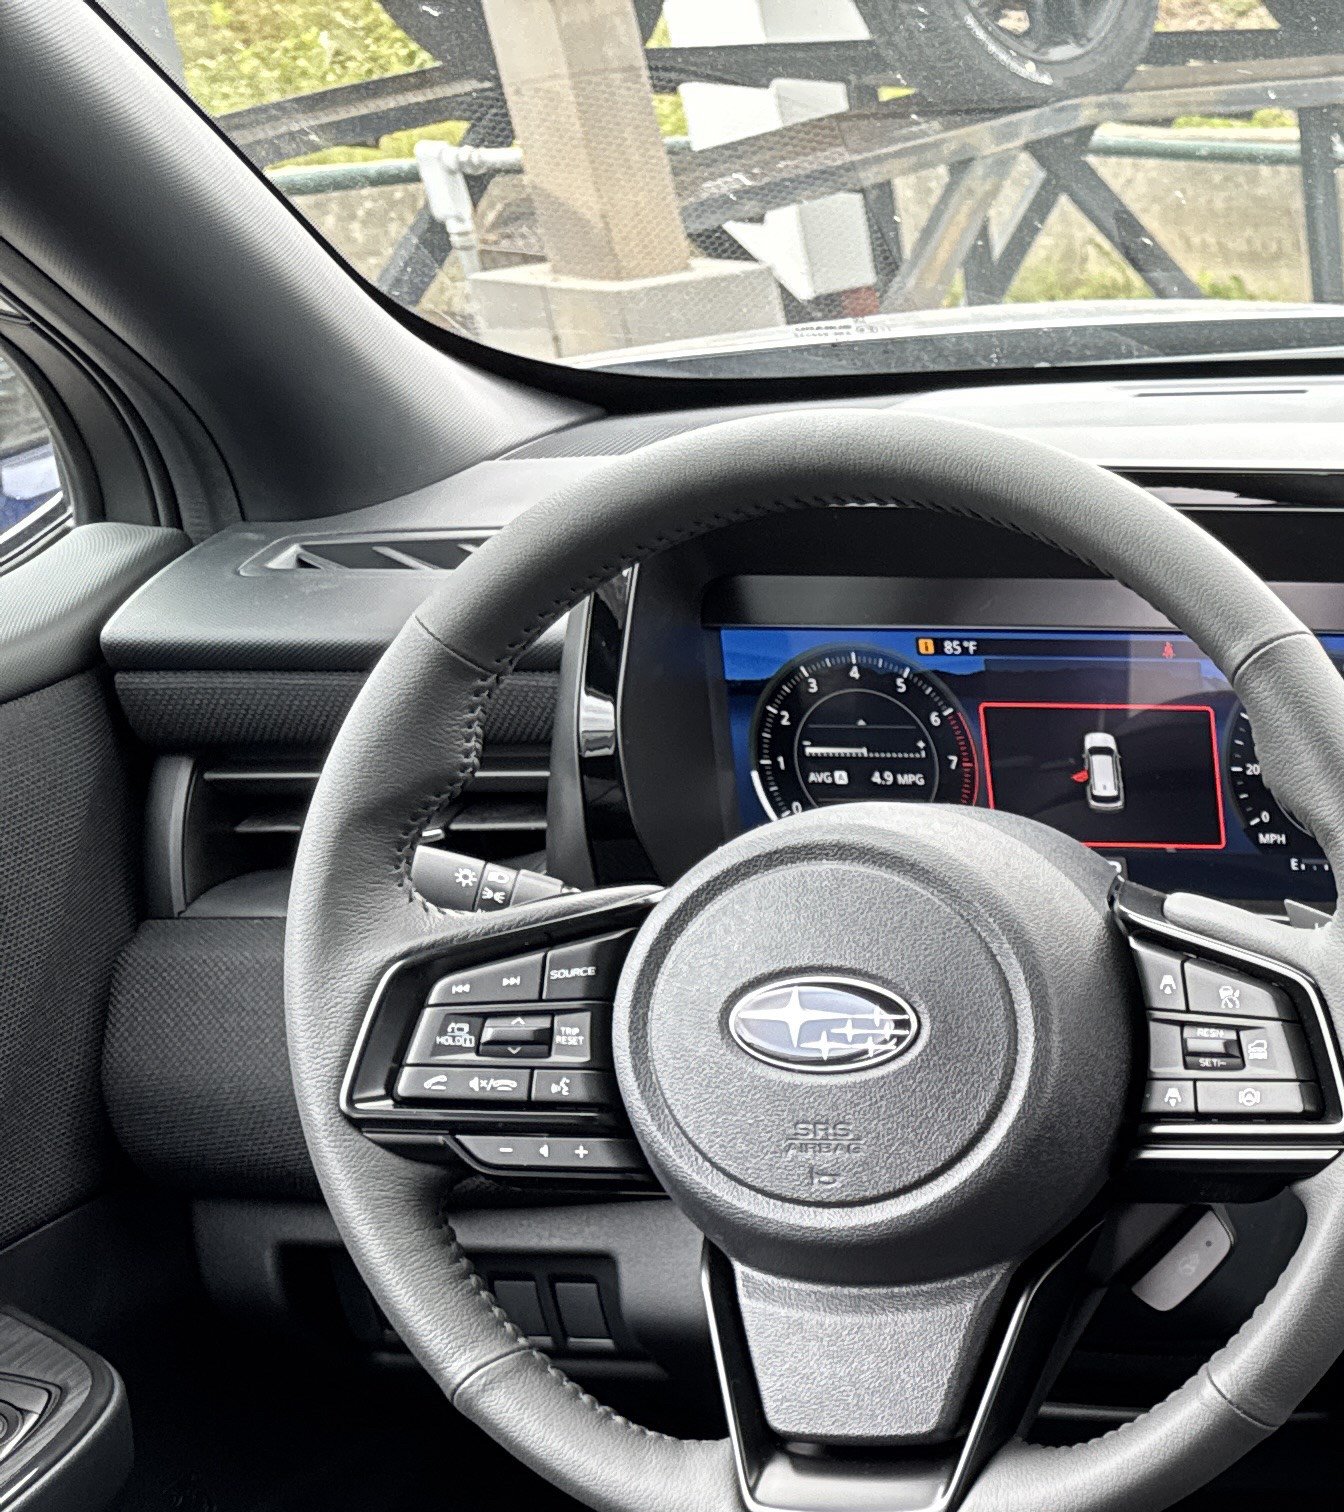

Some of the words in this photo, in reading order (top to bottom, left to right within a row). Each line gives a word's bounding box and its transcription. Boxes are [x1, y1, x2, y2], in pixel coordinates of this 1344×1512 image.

[943, 640, 978, 655] 85°F
[849, 665, 860, 680] 4
[808, 678, 819, 694] 3
[896, 677, 907, 693] 5
[780, 710, 791, 726] 2
[929, 711, 941, 727] 6
[777, 756, 786, 771] 1
[947, 755, 958, 770] 7
[808, 771, 832, 784] AVG
[871, 771, 894, 785] 4.9
[896, 772, 925, 785] MPG
[1260, 811, 1270, 823] 0
[1258, 833, 1287, 845] MPH
[549, 966, 597, 980] SOURCE
[559, 1026, 581, 1037] TRIP
[555, 1034, 585, 1046] RESET
[793, 1122, 853, 1140] SRS
[782, 1142, 864, 1155] AIRBAG
